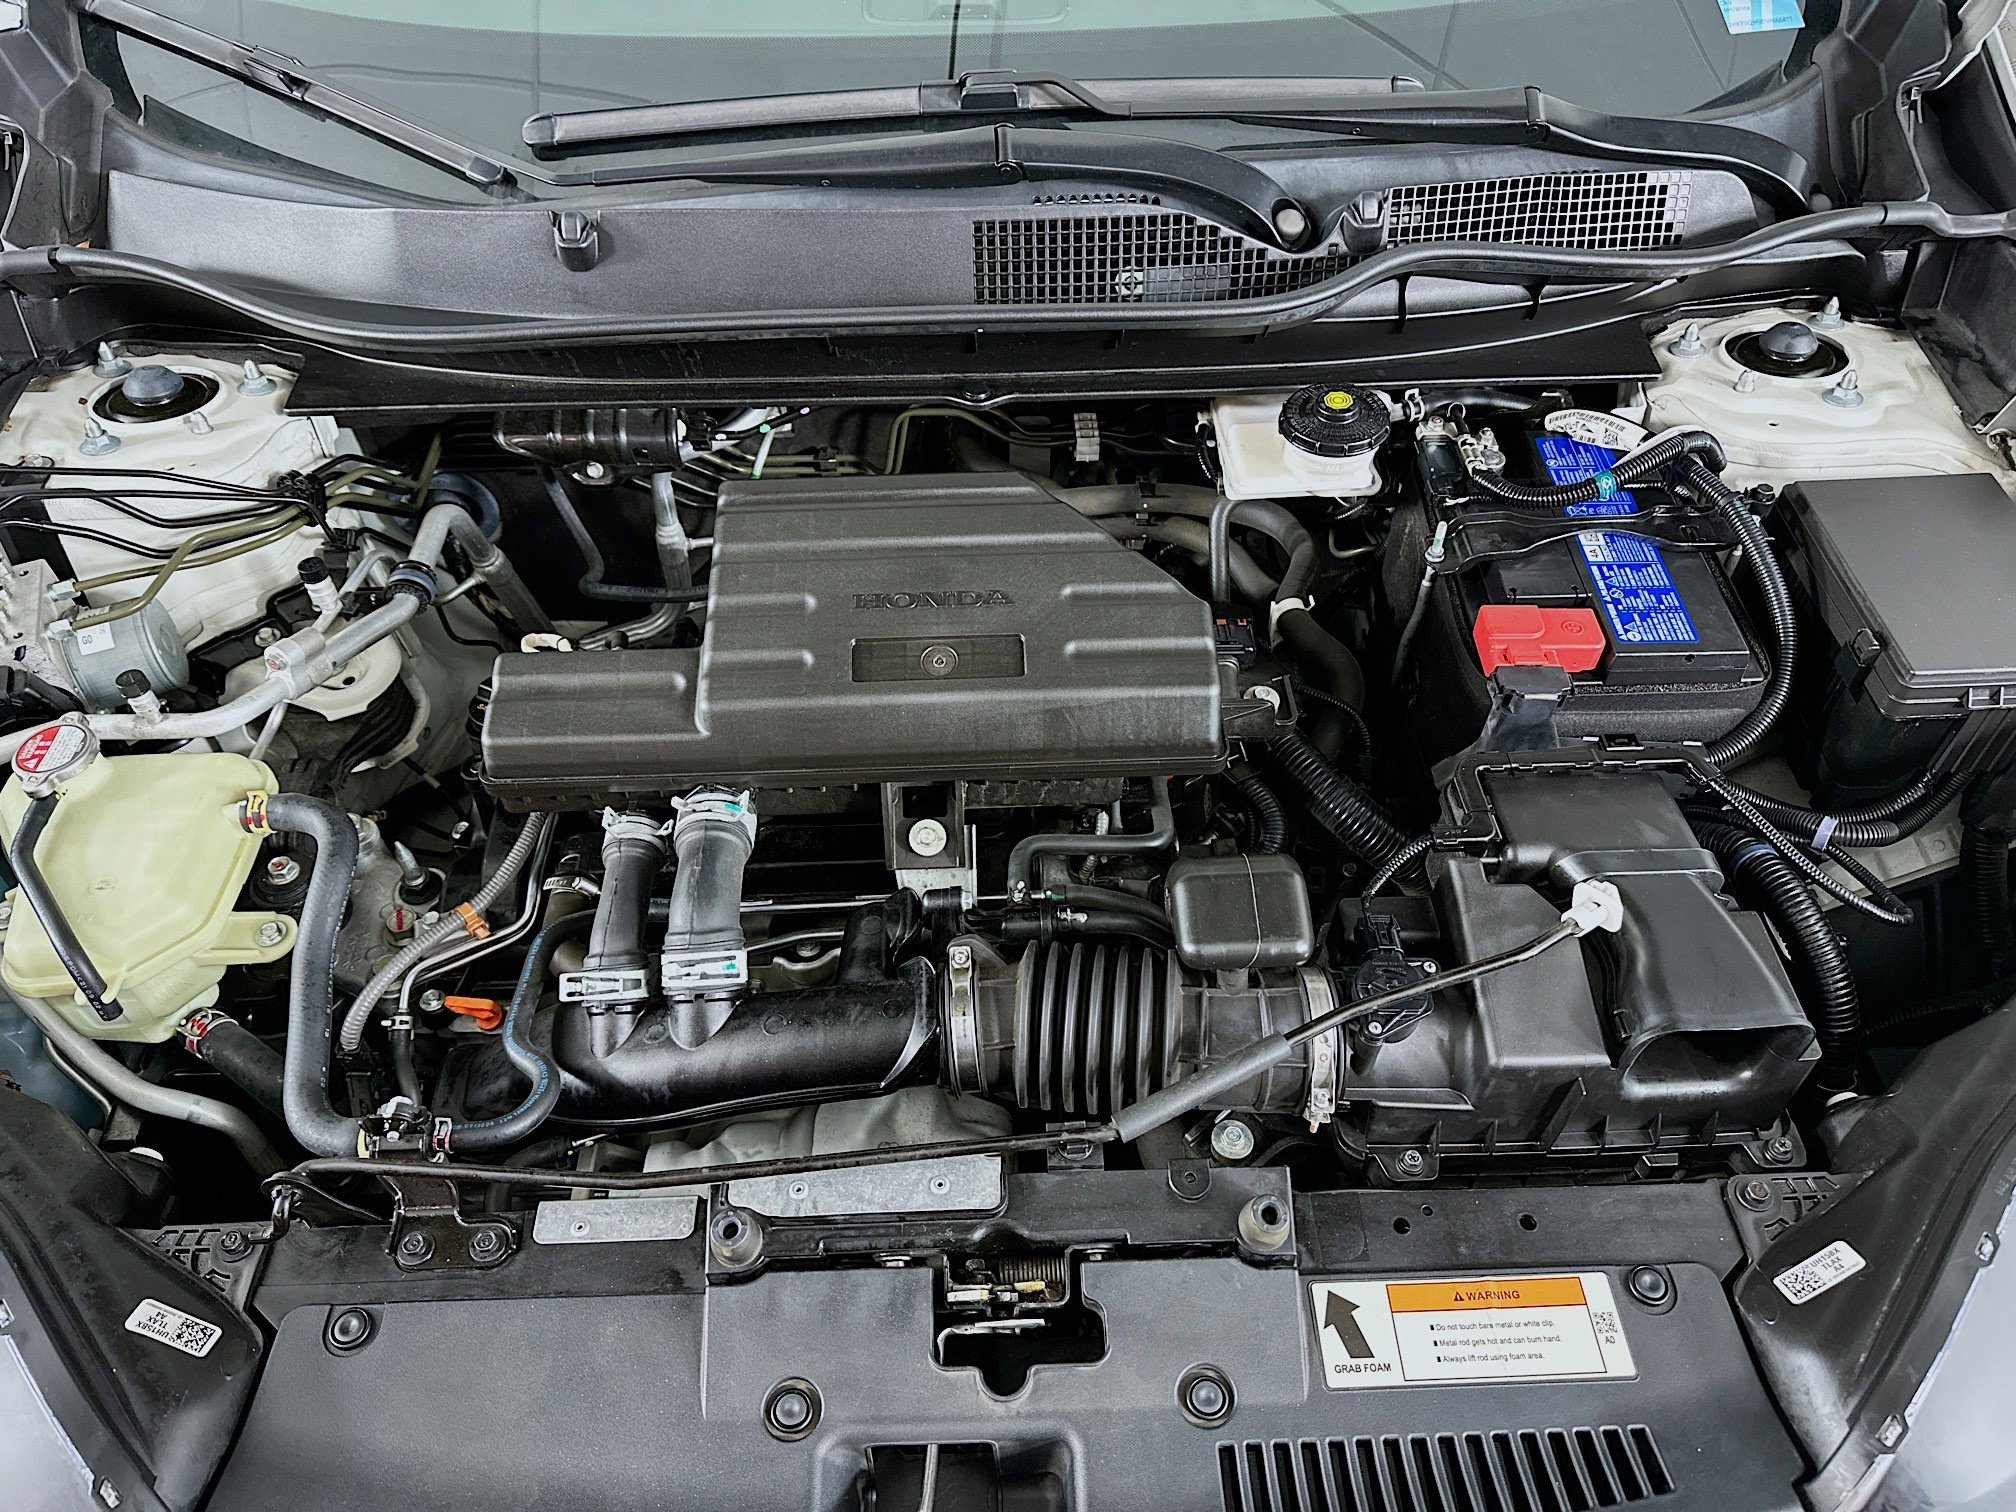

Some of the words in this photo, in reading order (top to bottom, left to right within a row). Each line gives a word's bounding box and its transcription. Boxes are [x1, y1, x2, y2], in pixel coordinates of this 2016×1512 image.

[851, 589, 1018, 611] HONDA
[1465, 1290, 1521, 1301] WARNING
[1447, 1323, 1459, 1331] not
[1460, 1322, 1478, 1330] touch
[1479, 1321, 1494, 1329] bare
[1495, 1321, 1514, 1329] metal
[1523, 1319, 1541, 1327] white
[1439, 1339, 1458, 1347] Metal
[1459, 1338, 1471, 1346] rod
[1472, 1338, 1486, 1348] gets
[1487, 1337, 1498, 1345] hot
[1499, 1336, 1512, 1345] and
[1513, 1336, 1526, 1344] can
[1443, 1355, 1467, 1364] Always
[1468, 1354, 1476, 1362] lift
[1477, 1353, 1489, 1361] rod
[1490, 1353, 1509, 1362] using
[1509, 1352, 1527, 1360] foam
[1334, 1364, 1362, 1374] GRAB
[1364, 1363, 1392, 1373] FOAM
